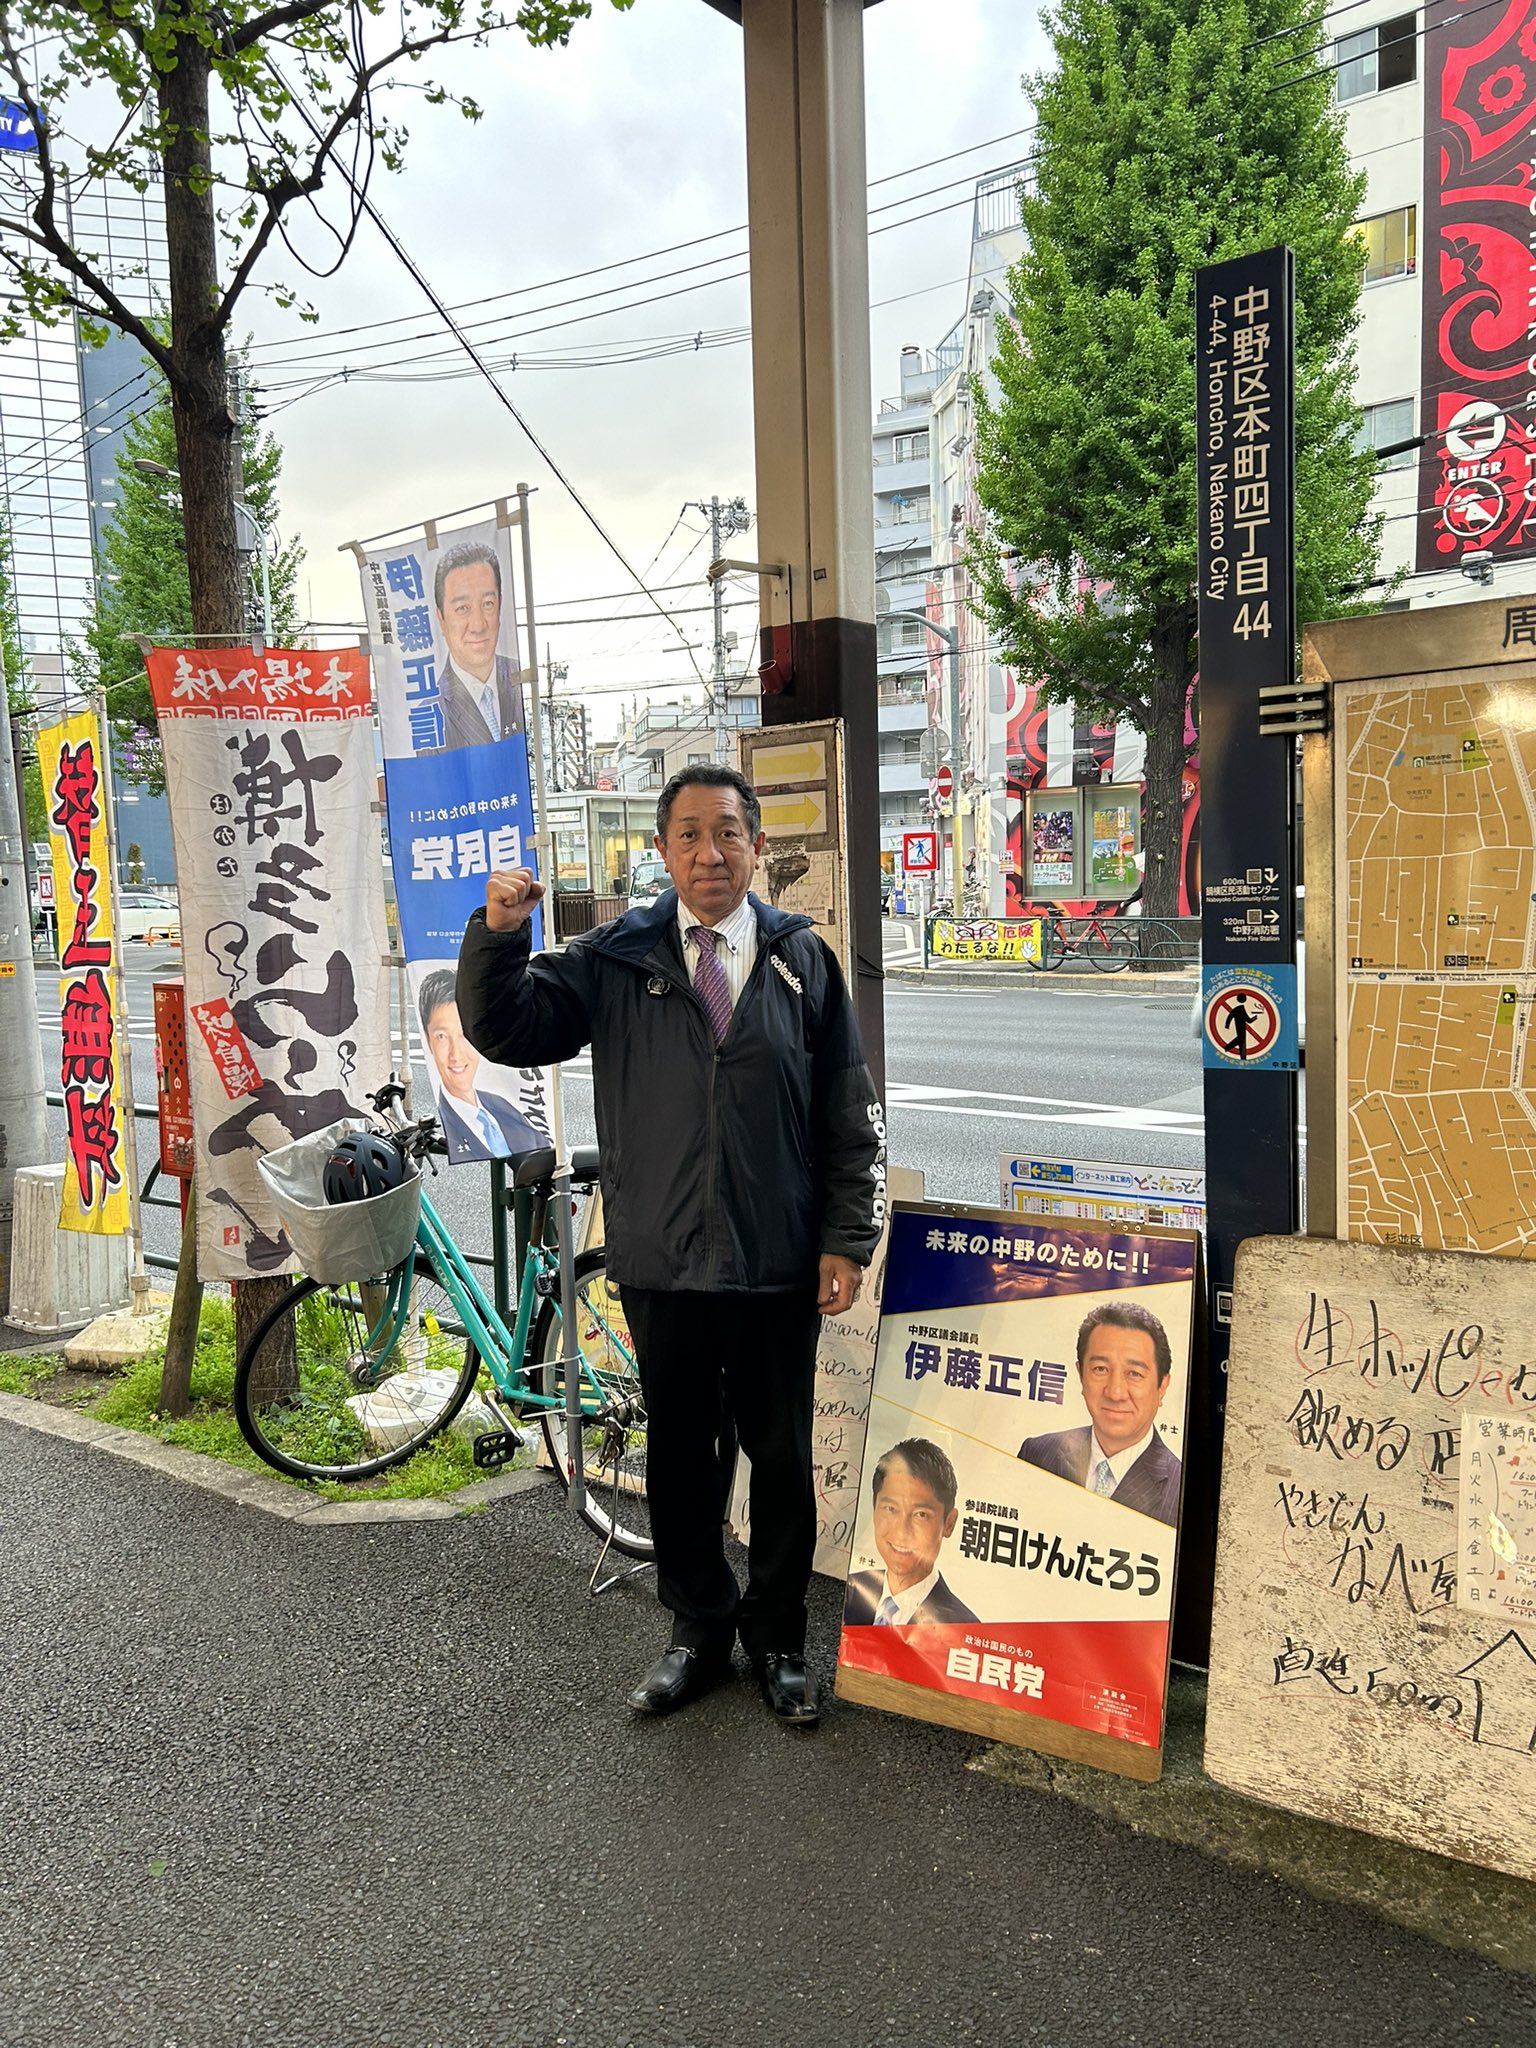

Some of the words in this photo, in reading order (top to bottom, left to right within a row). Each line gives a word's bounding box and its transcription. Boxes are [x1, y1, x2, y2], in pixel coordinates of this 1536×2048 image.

[1204, 295, 1228, 355] 4-44,
[1205, 360, 1229, 458] Honcho,
[1232, 285, 1271, 596] 中野区本町四丁目
[1448, 461, 1502, 481] ENTER
[1208, 466, 1229, 550] Nakano
[1205, 556, 1230, 600] City
[1232, 601, 1272, 641] 44
[1003, 923, 1034, 939] 危険
[1232, 925, 1280, 935] 中野消防署
[940, 941, 1015, 955] わたるな!!
[925, 1229, 1150, 1275] 未来の中野のために!!
[1385, 1232, 1422, 1247] 杉並区
[908, 1324, 979, 1345] 中野区議会議員
[905, 1340, 1068, 1405] 伊藤正信
[1160, 1423, 1179, 1434] 弁士
[965, 1498, 1019, 1522] 参議院議員
[959, 1516, 1161, 1597] 朝日けんたろう
[965, 1634, 1034, 1659] 政治は国民のもの
[946, 1647, 1046, 1700] 自民党
[1103, 1688, 1127, 1701] 演説会
